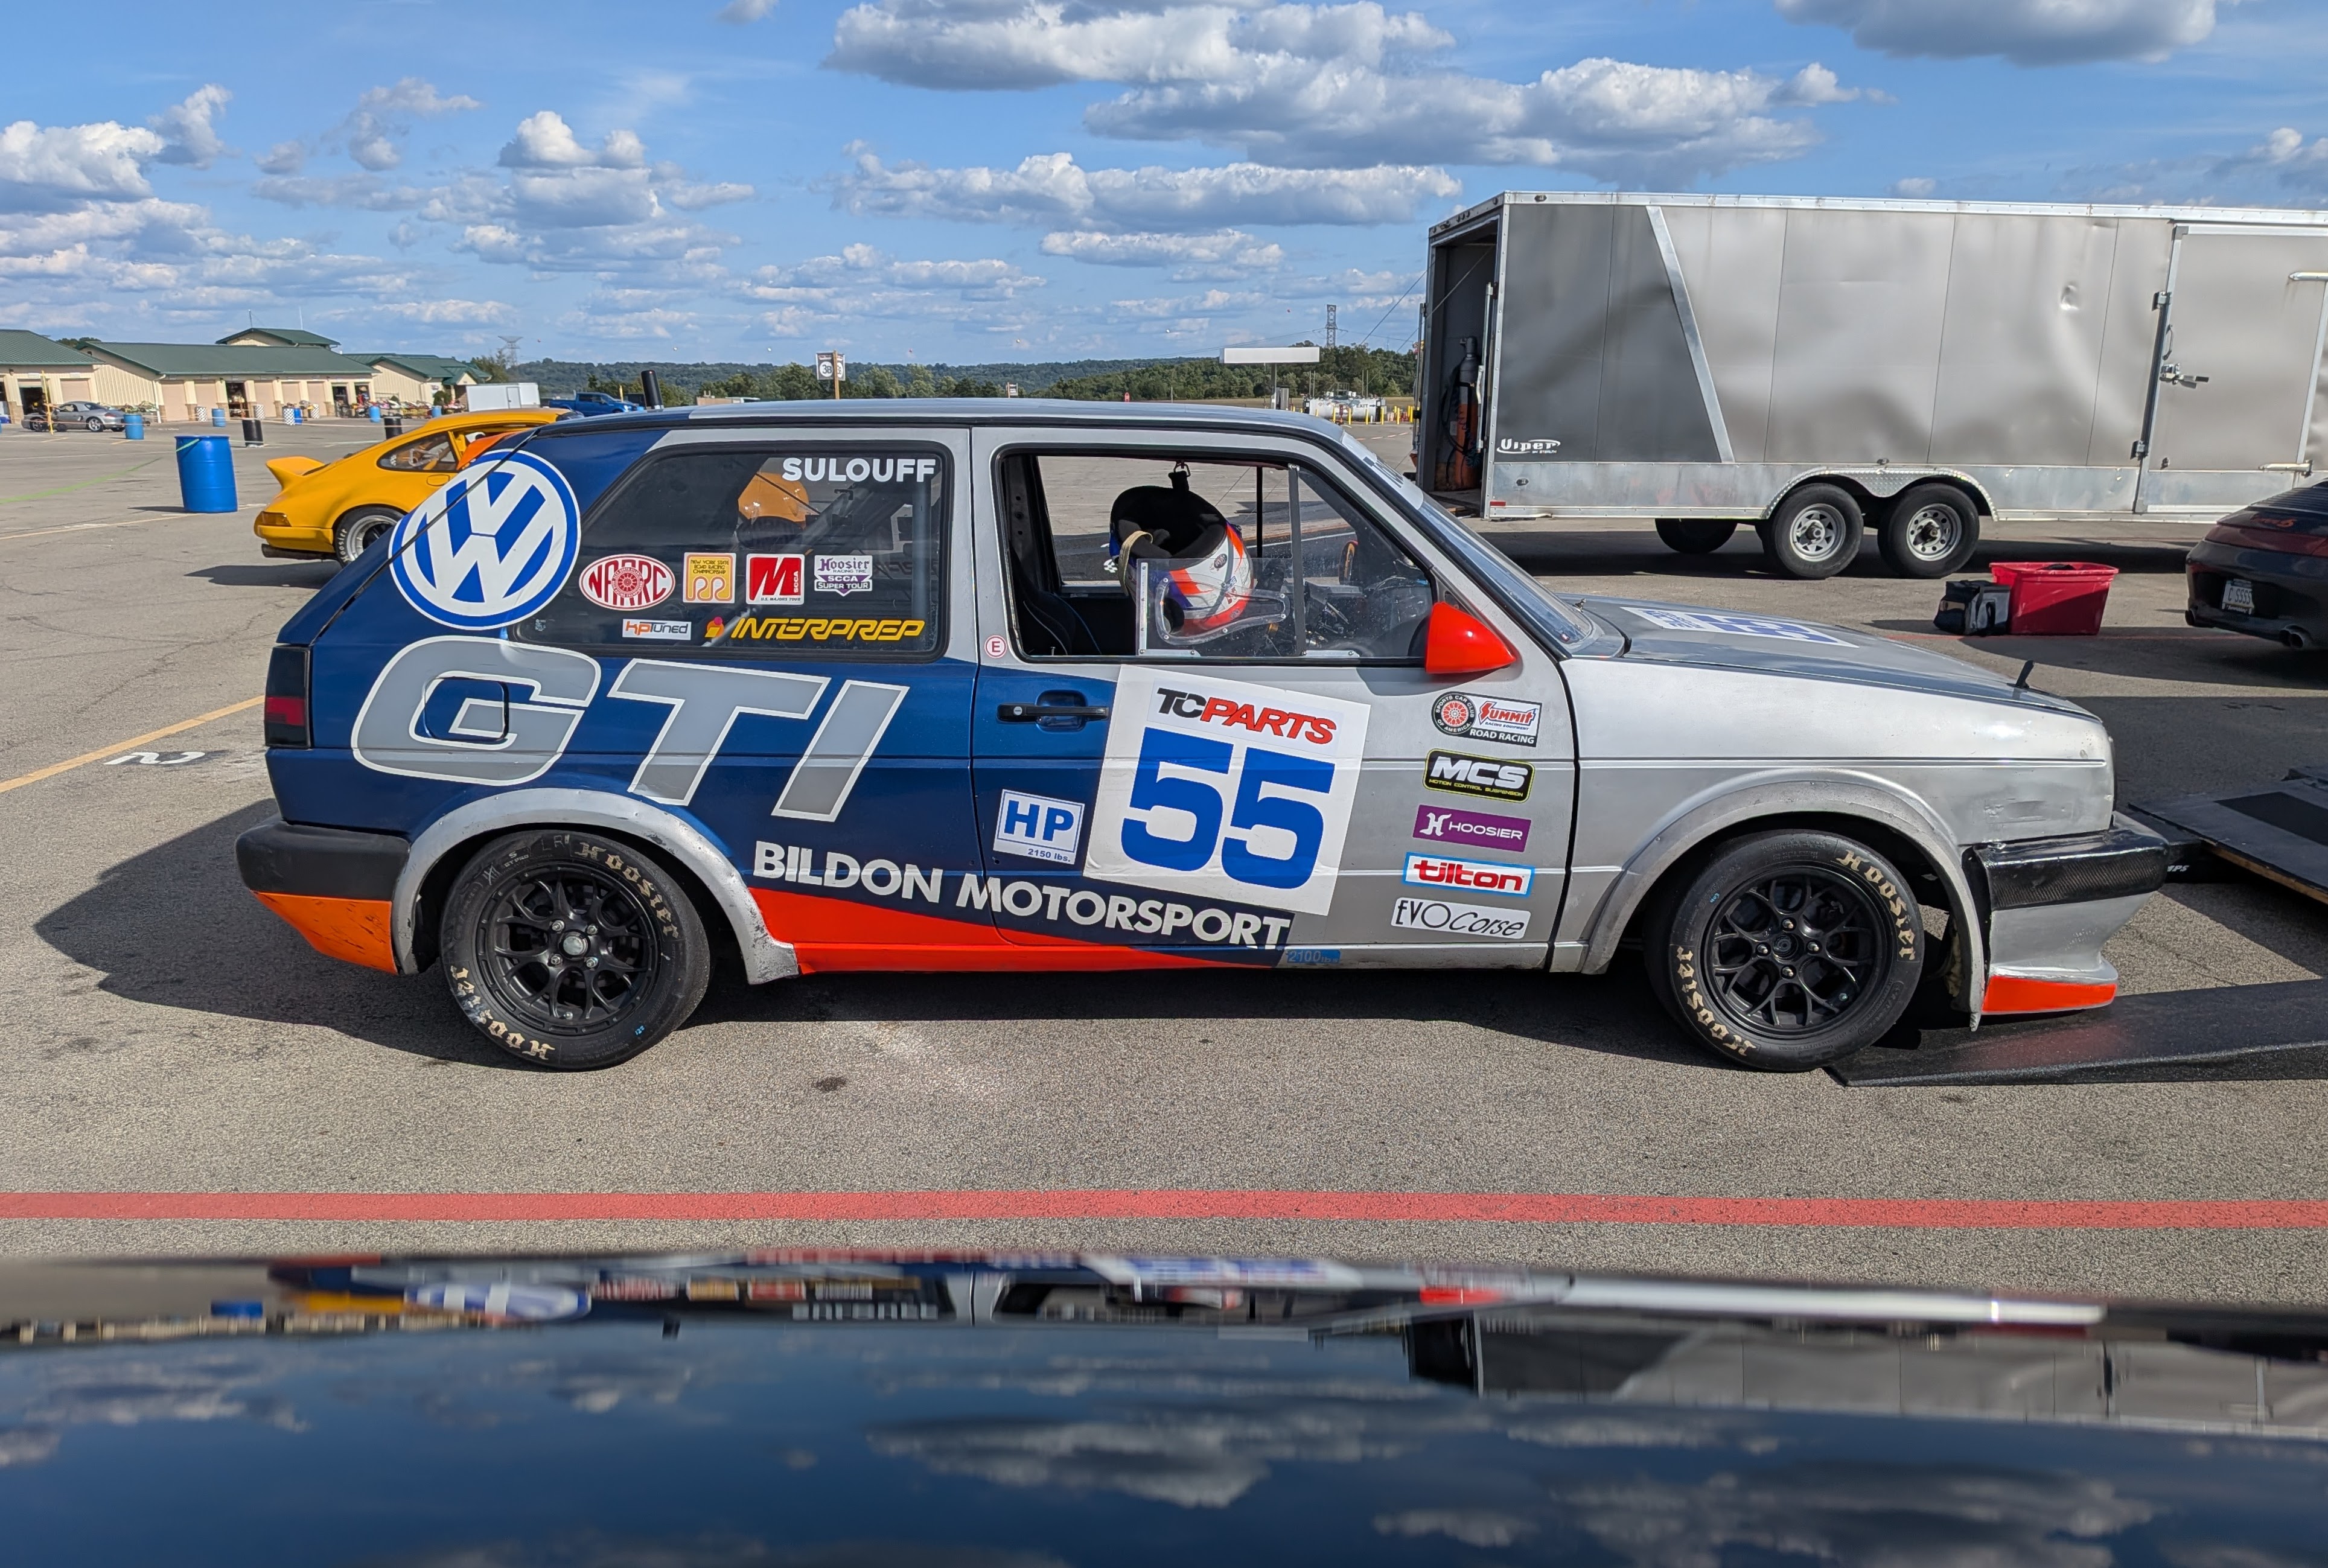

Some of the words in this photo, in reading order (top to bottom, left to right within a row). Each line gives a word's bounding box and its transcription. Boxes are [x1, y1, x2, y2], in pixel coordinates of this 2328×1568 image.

[822, 365, 832, 374] 3B
[782, 457, 936, 482] SULOUFF
[817, 557, 870, 572] Hoosier
[730, 617, 925, 641] INTERPREP
[992, 641, 1001, 652] E
[1156, 687, 1338, 745] TCPARTS
[1435, 695, 1453, 713] SPORTS
[351, 635, 910, 822] GTI
[1444, 723, 1471, 733] AMERICA
[1469, 728, 1497, 739] ROAD
[1498, 734, 1535, 744] RACING
[1430, 756, 1528, 789] MCS
[1485, 787, 1523, 797] SUSPENSION
[1121, 726, 1335, 890] 55
[1004, 800, 1074, 841] HP
[1449, 821, 1523, 840] HOOSIER
[1028, 849, 1051, 858] 2150
[1054, 853, 1071, 862] lbs.
[1413, 859, 1523, 891] tilton
[753, 840, 943, 904] BILDON
[956, 874, 1291, 950] MOTORSPORT
[1836, 849, 1916, 960] Hoosier
